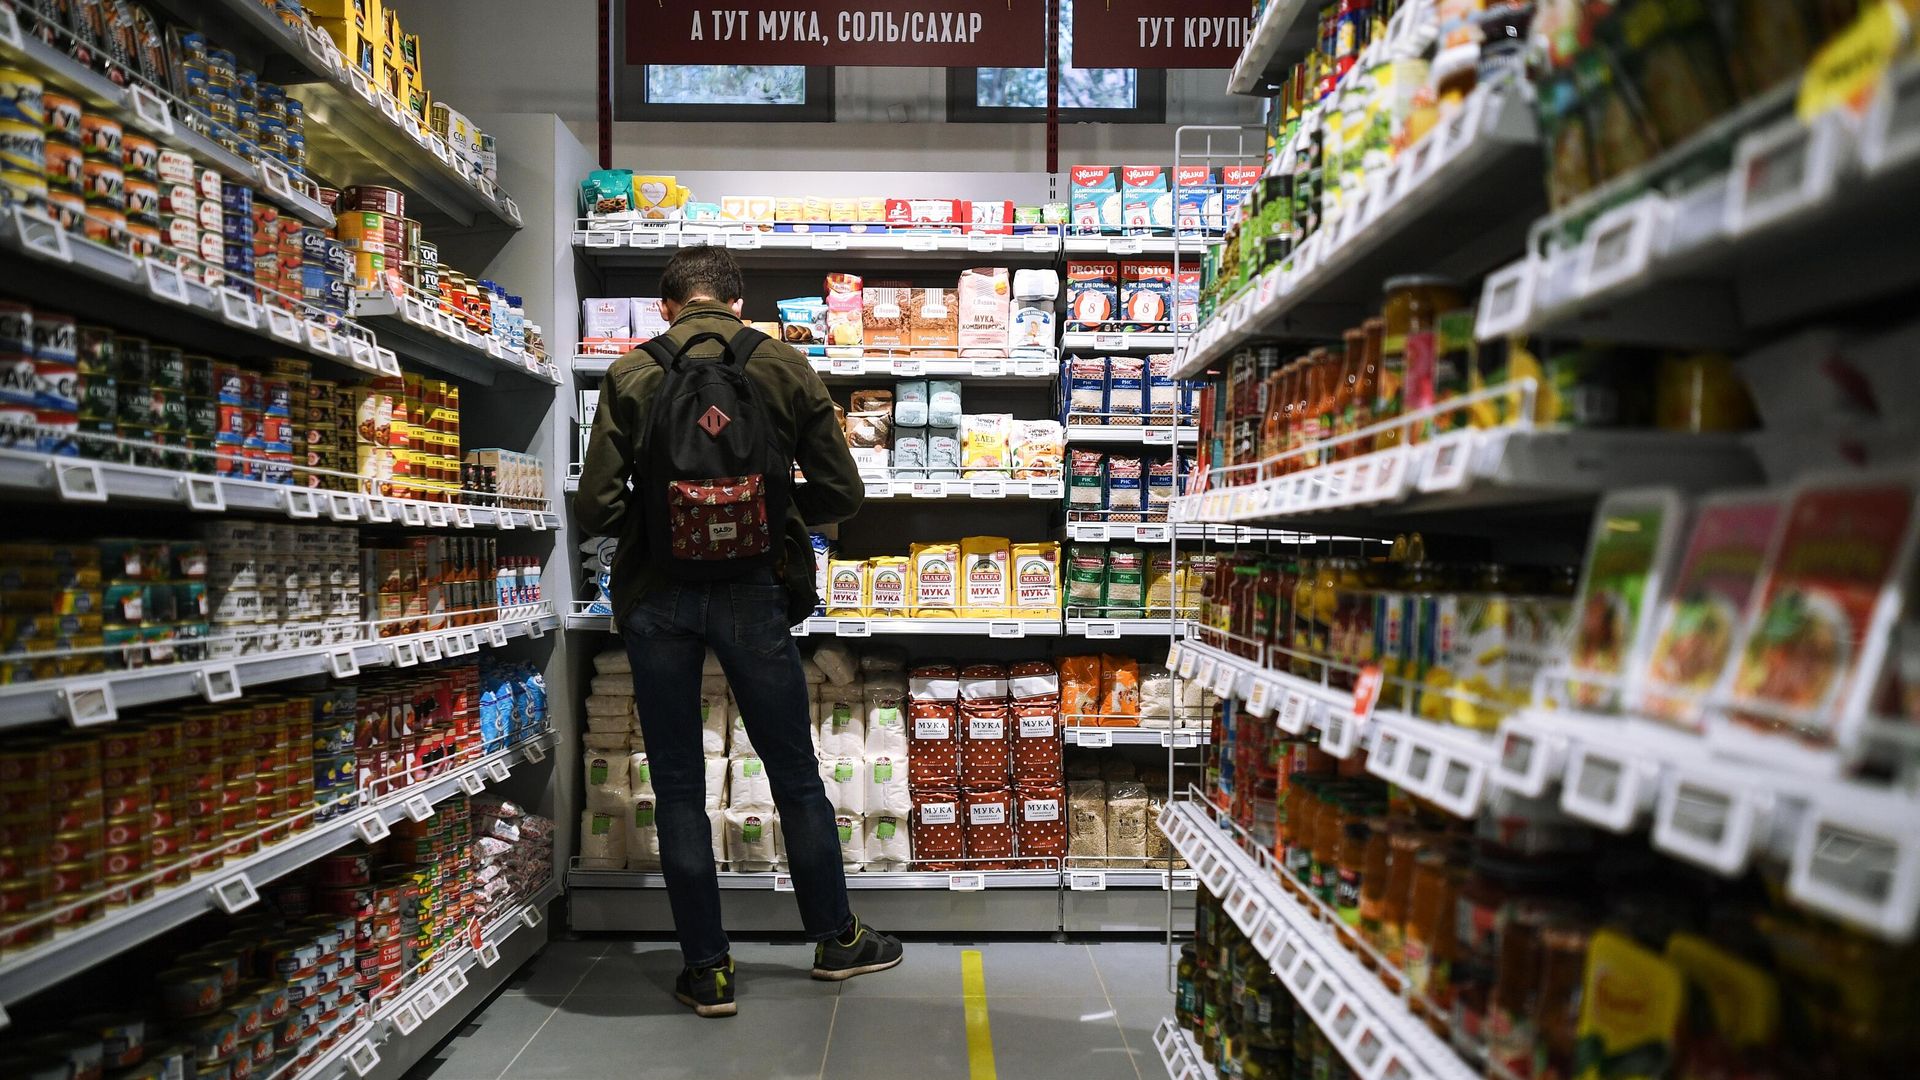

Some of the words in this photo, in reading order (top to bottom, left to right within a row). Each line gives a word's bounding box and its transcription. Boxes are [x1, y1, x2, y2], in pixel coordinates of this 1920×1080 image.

[691, 10, 703, 41] А
[712, 10, 749, 41] ТУТ
[759, 11, 829, 46] МУКА,
[838, 11, 982, 43] СОЛЬ/САХАР
[1138, 17, 1174, 48] ТУТ
[1070, 265, 1115, 275] PROSTO
[1123, 265, 1169, 275] PROSTO
[1088, 303, 1096, 313] 8
[1142, 303, 1150, 313] 8
[973, 315, 995, 323] МУКА
[975, 435, 996, 443] ХЛЕБ
[923, 574, 950, 582] MAKFA
[971, 573, 999, 581] MAKFA
[1022, 575, 1049, 583] MAKFA
[921, 588, 951, 597] МУКА
[970, 587, 1000, 596] МУКА
[1021, 589, 1051, 598] МУКА
[1022, 720, 1052, 728] МУКА
[923, 806, 953, 814] МУКА
[973, 807, 1002, 815] МУКА
[1028, 803, 1057, 811] МУКА
